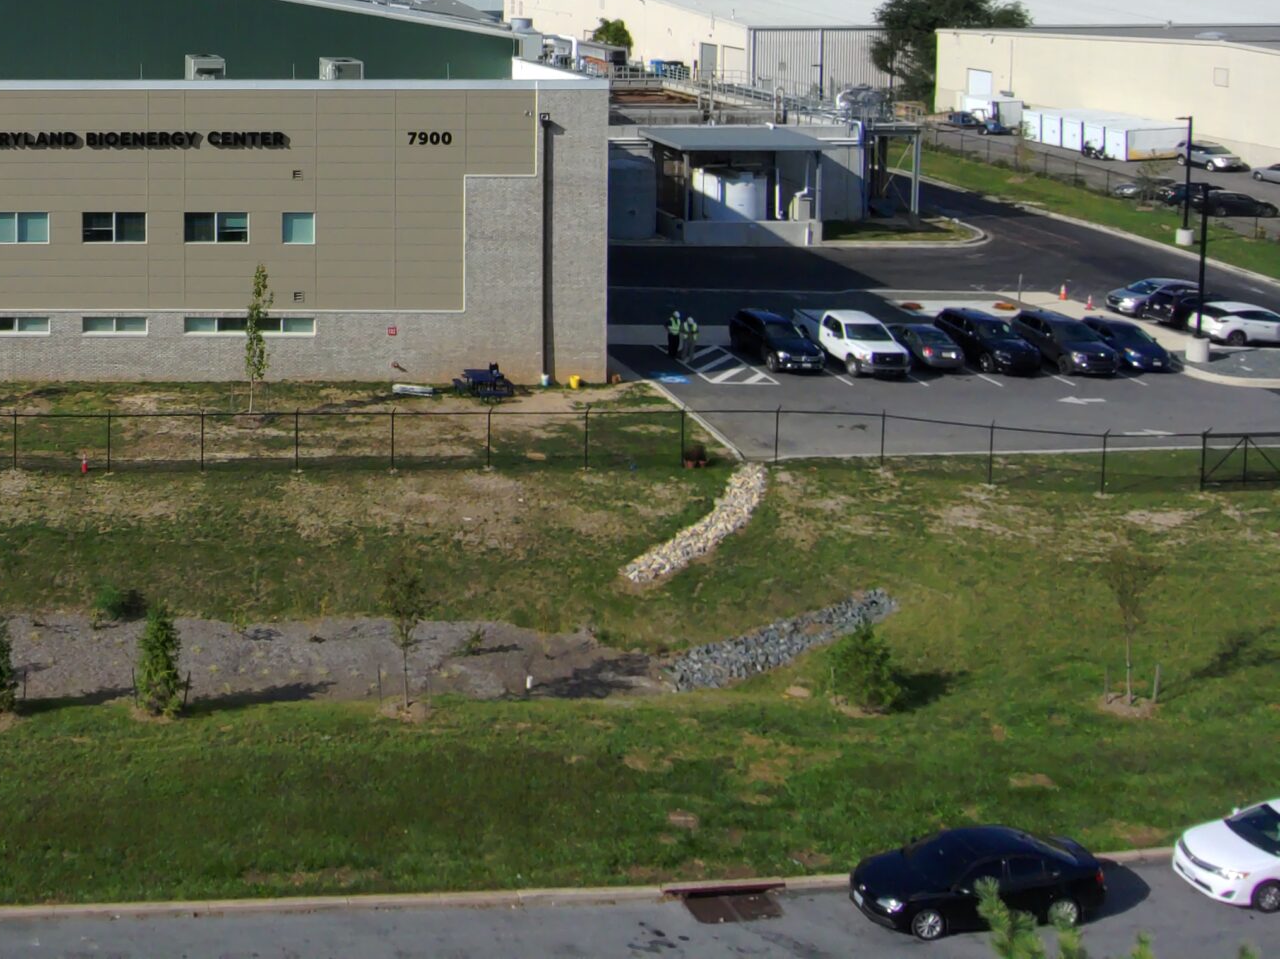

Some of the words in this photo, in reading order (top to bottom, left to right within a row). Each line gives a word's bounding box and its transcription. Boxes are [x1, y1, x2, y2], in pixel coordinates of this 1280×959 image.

[86, 131, 198, 147] BIOENERGY
[207, 131, 285, 147] CENTER
[407, 131, 453, 146] 7900
